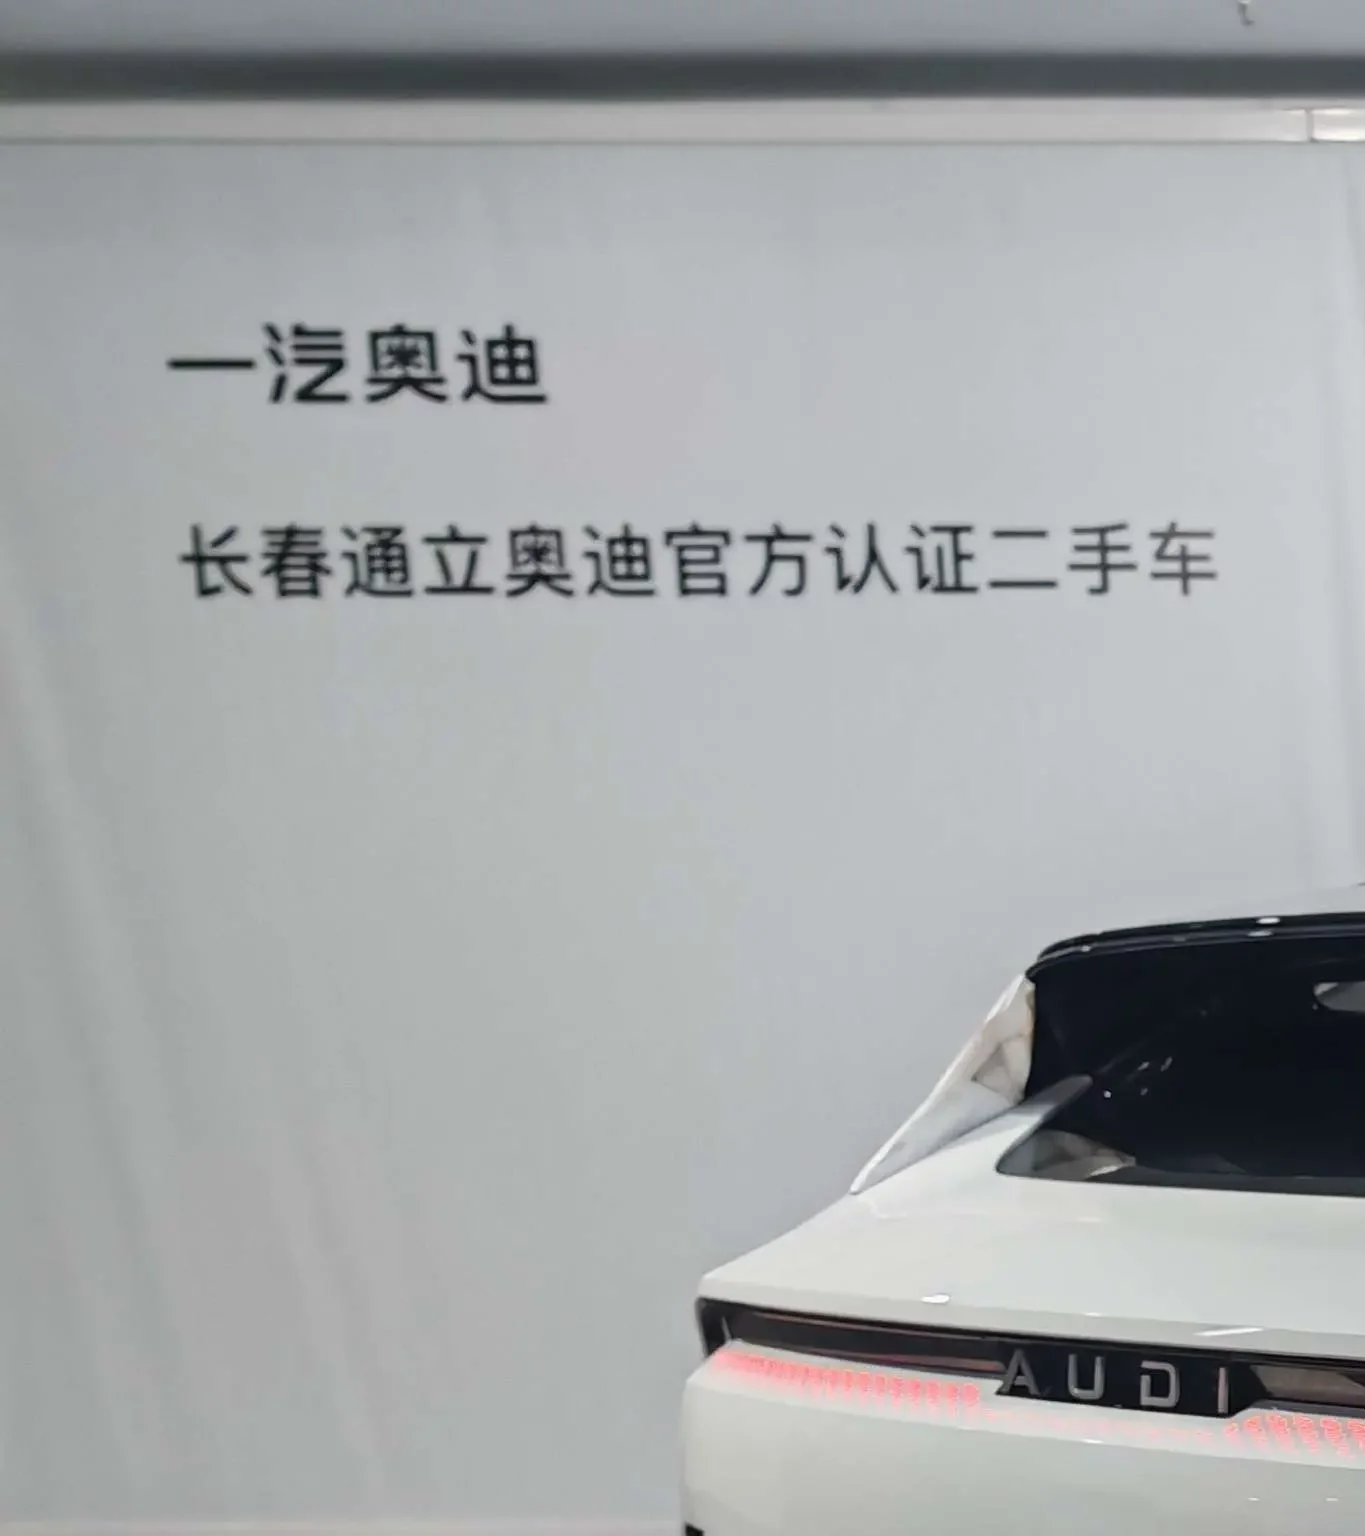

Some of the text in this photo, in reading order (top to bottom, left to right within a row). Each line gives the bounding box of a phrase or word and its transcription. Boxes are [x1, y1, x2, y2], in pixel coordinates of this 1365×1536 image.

[167, 322, 549, 404] 一汽奥迪
[178, 521, 1218, 600] 长春通立奥迪官方认证二手车
[1000, 1348, 1230, 1415] AUDI
